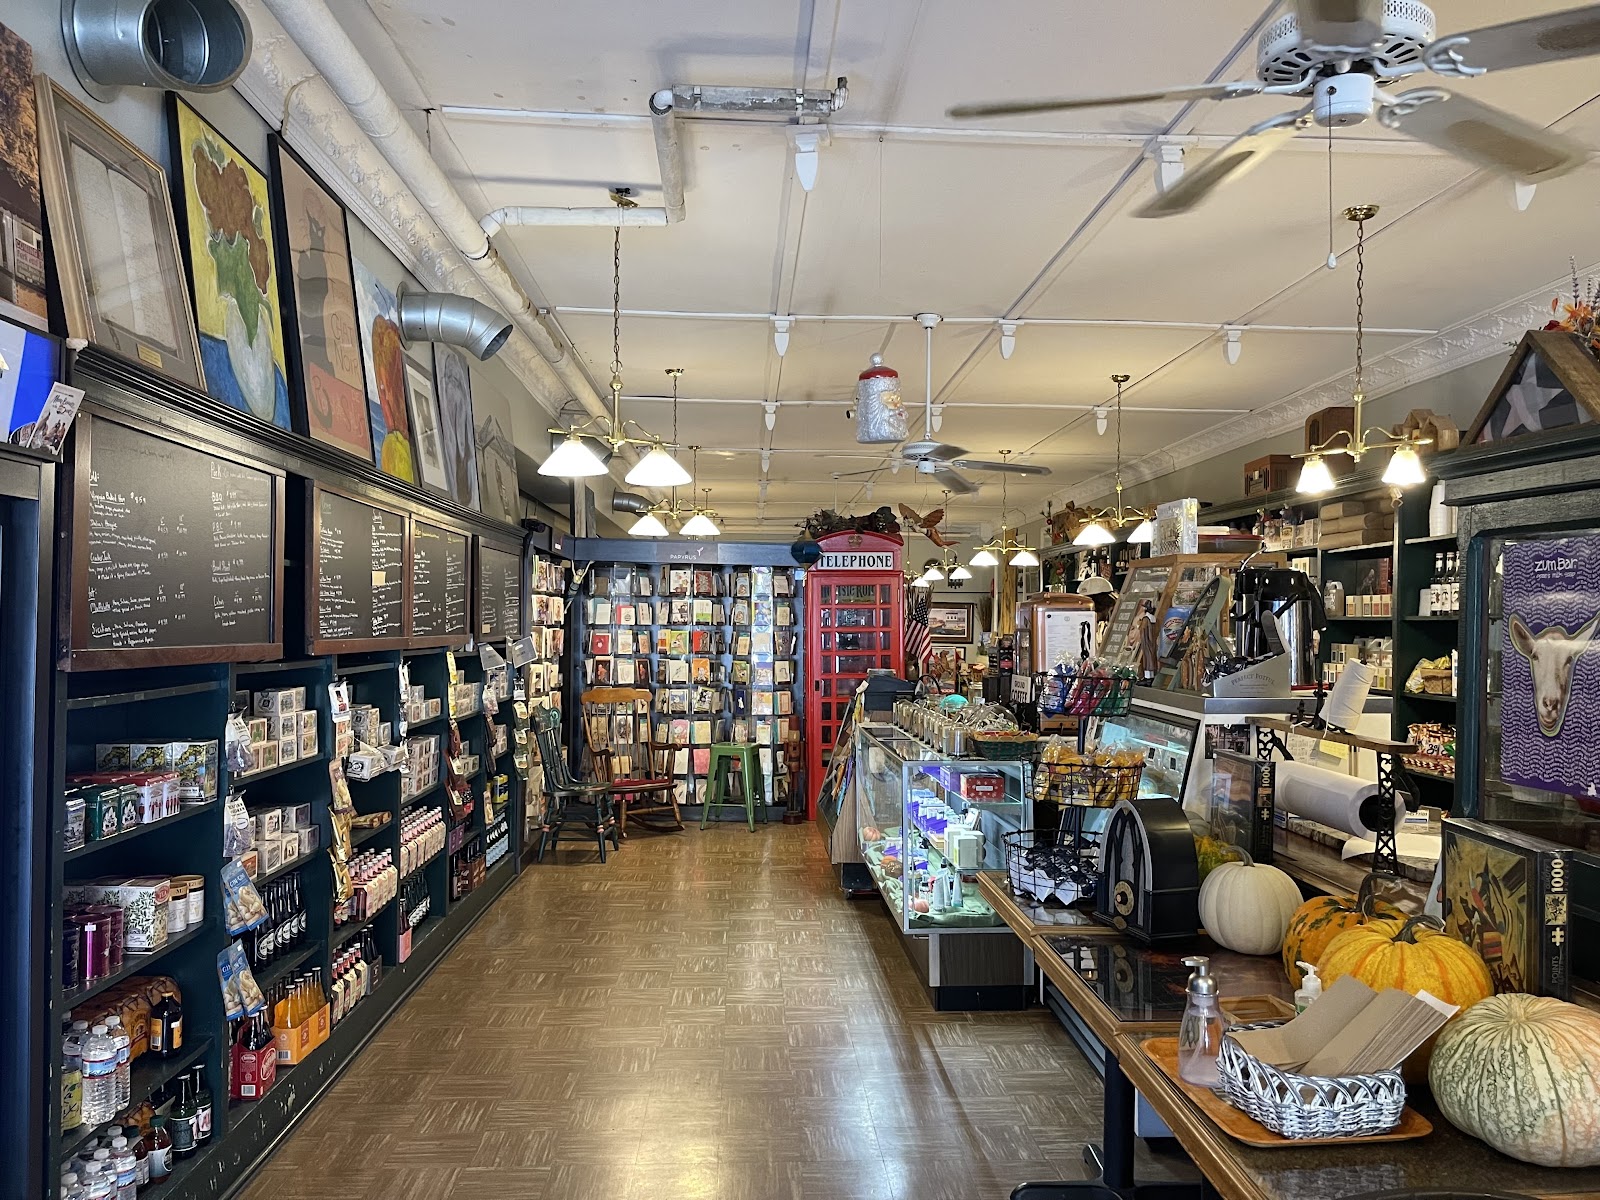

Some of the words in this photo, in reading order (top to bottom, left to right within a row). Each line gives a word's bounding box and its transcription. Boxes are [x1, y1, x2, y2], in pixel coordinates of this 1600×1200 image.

[820, 555, 893, 568] TELEPHONE
[1261, 766, 1271, 787] 1000
[1551, 858, 1565, 893] 1000
[1551, 955, 1559, 984] POINTS
